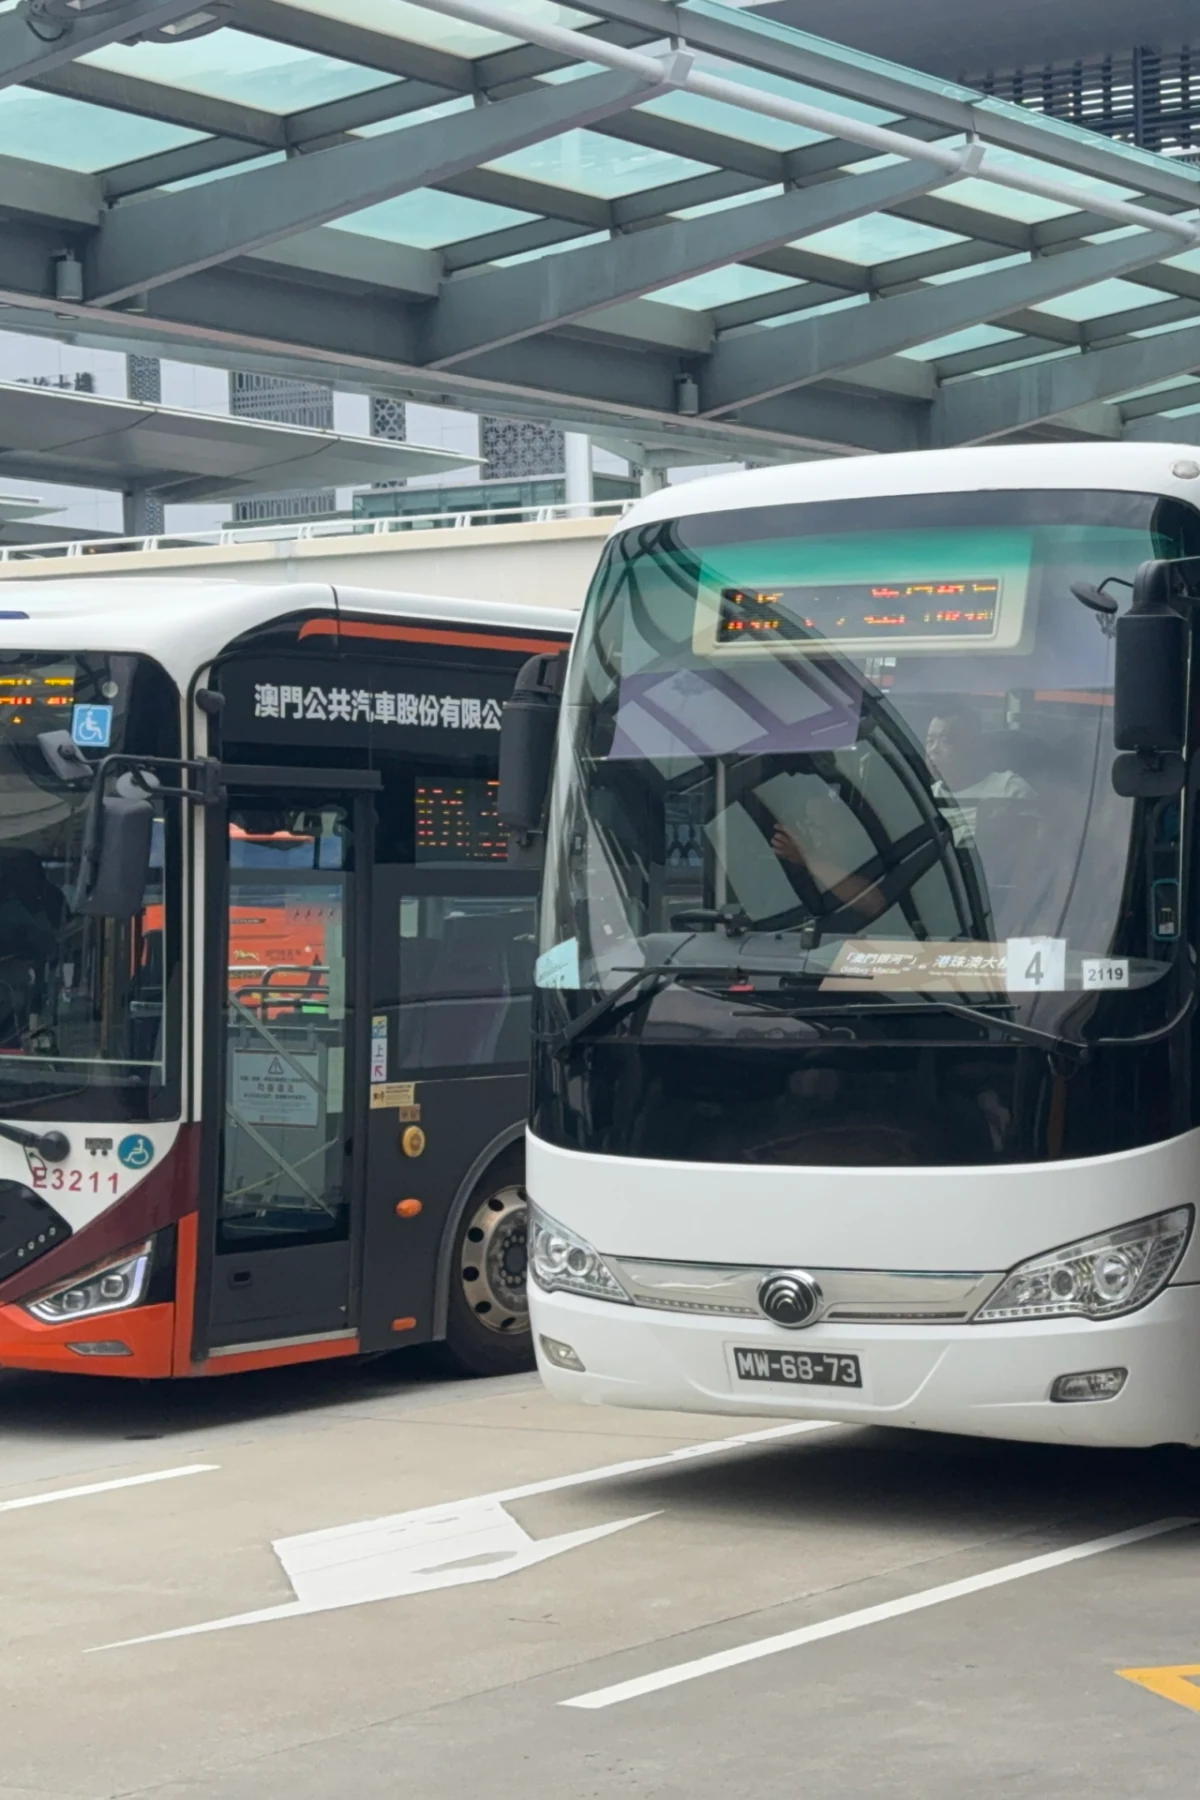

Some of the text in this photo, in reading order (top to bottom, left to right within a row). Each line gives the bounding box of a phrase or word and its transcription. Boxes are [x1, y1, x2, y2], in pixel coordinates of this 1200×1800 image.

[1024, 950, 1044, 985] 4
[1087, 967, 1124, 981] 2119
[737, 1351, 857, 1383] MW-68-73
